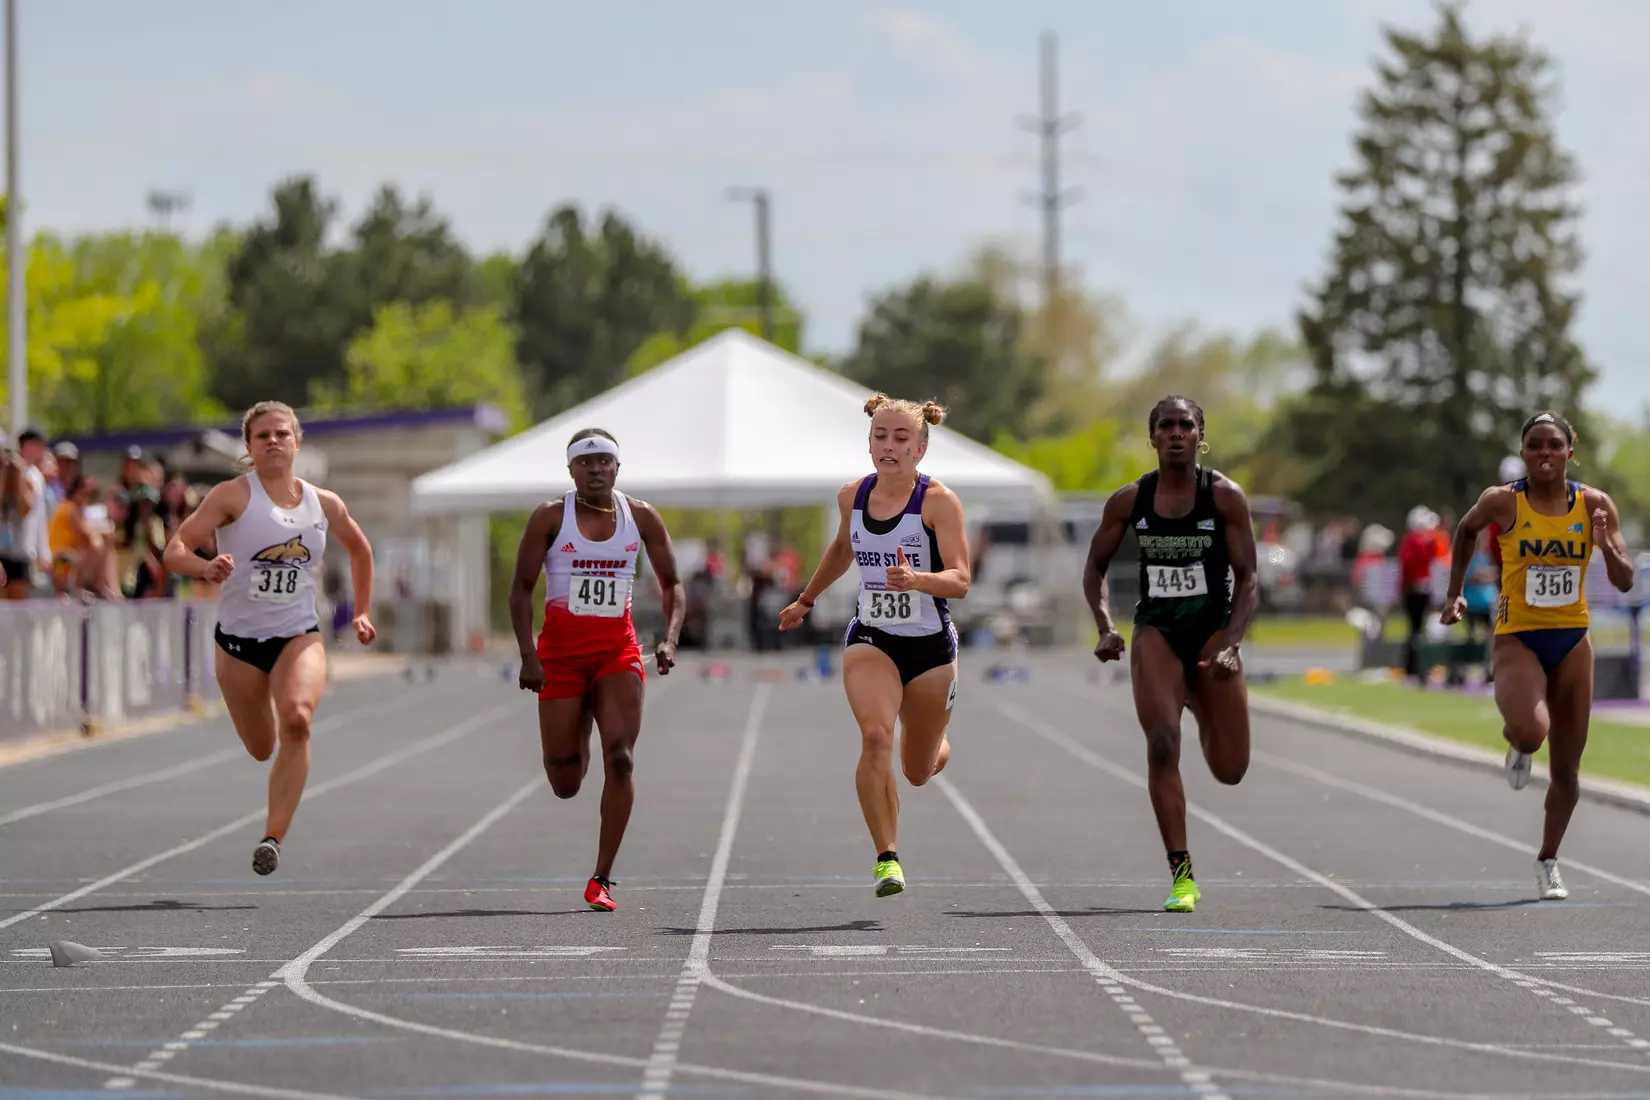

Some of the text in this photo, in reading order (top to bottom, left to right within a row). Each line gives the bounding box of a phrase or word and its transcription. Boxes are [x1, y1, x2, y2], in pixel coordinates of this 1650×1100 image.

[855, 551, 882, 567] EBER
[1520, 539, 1586, 558] NAU
[258, 569, 298, 593] 318
[1156, 568, 1197, 592] 445
[1535, 571, 1573, 596] 356
[578, 579, 617, 606] 491
[870, 592, 911, 619] 538
